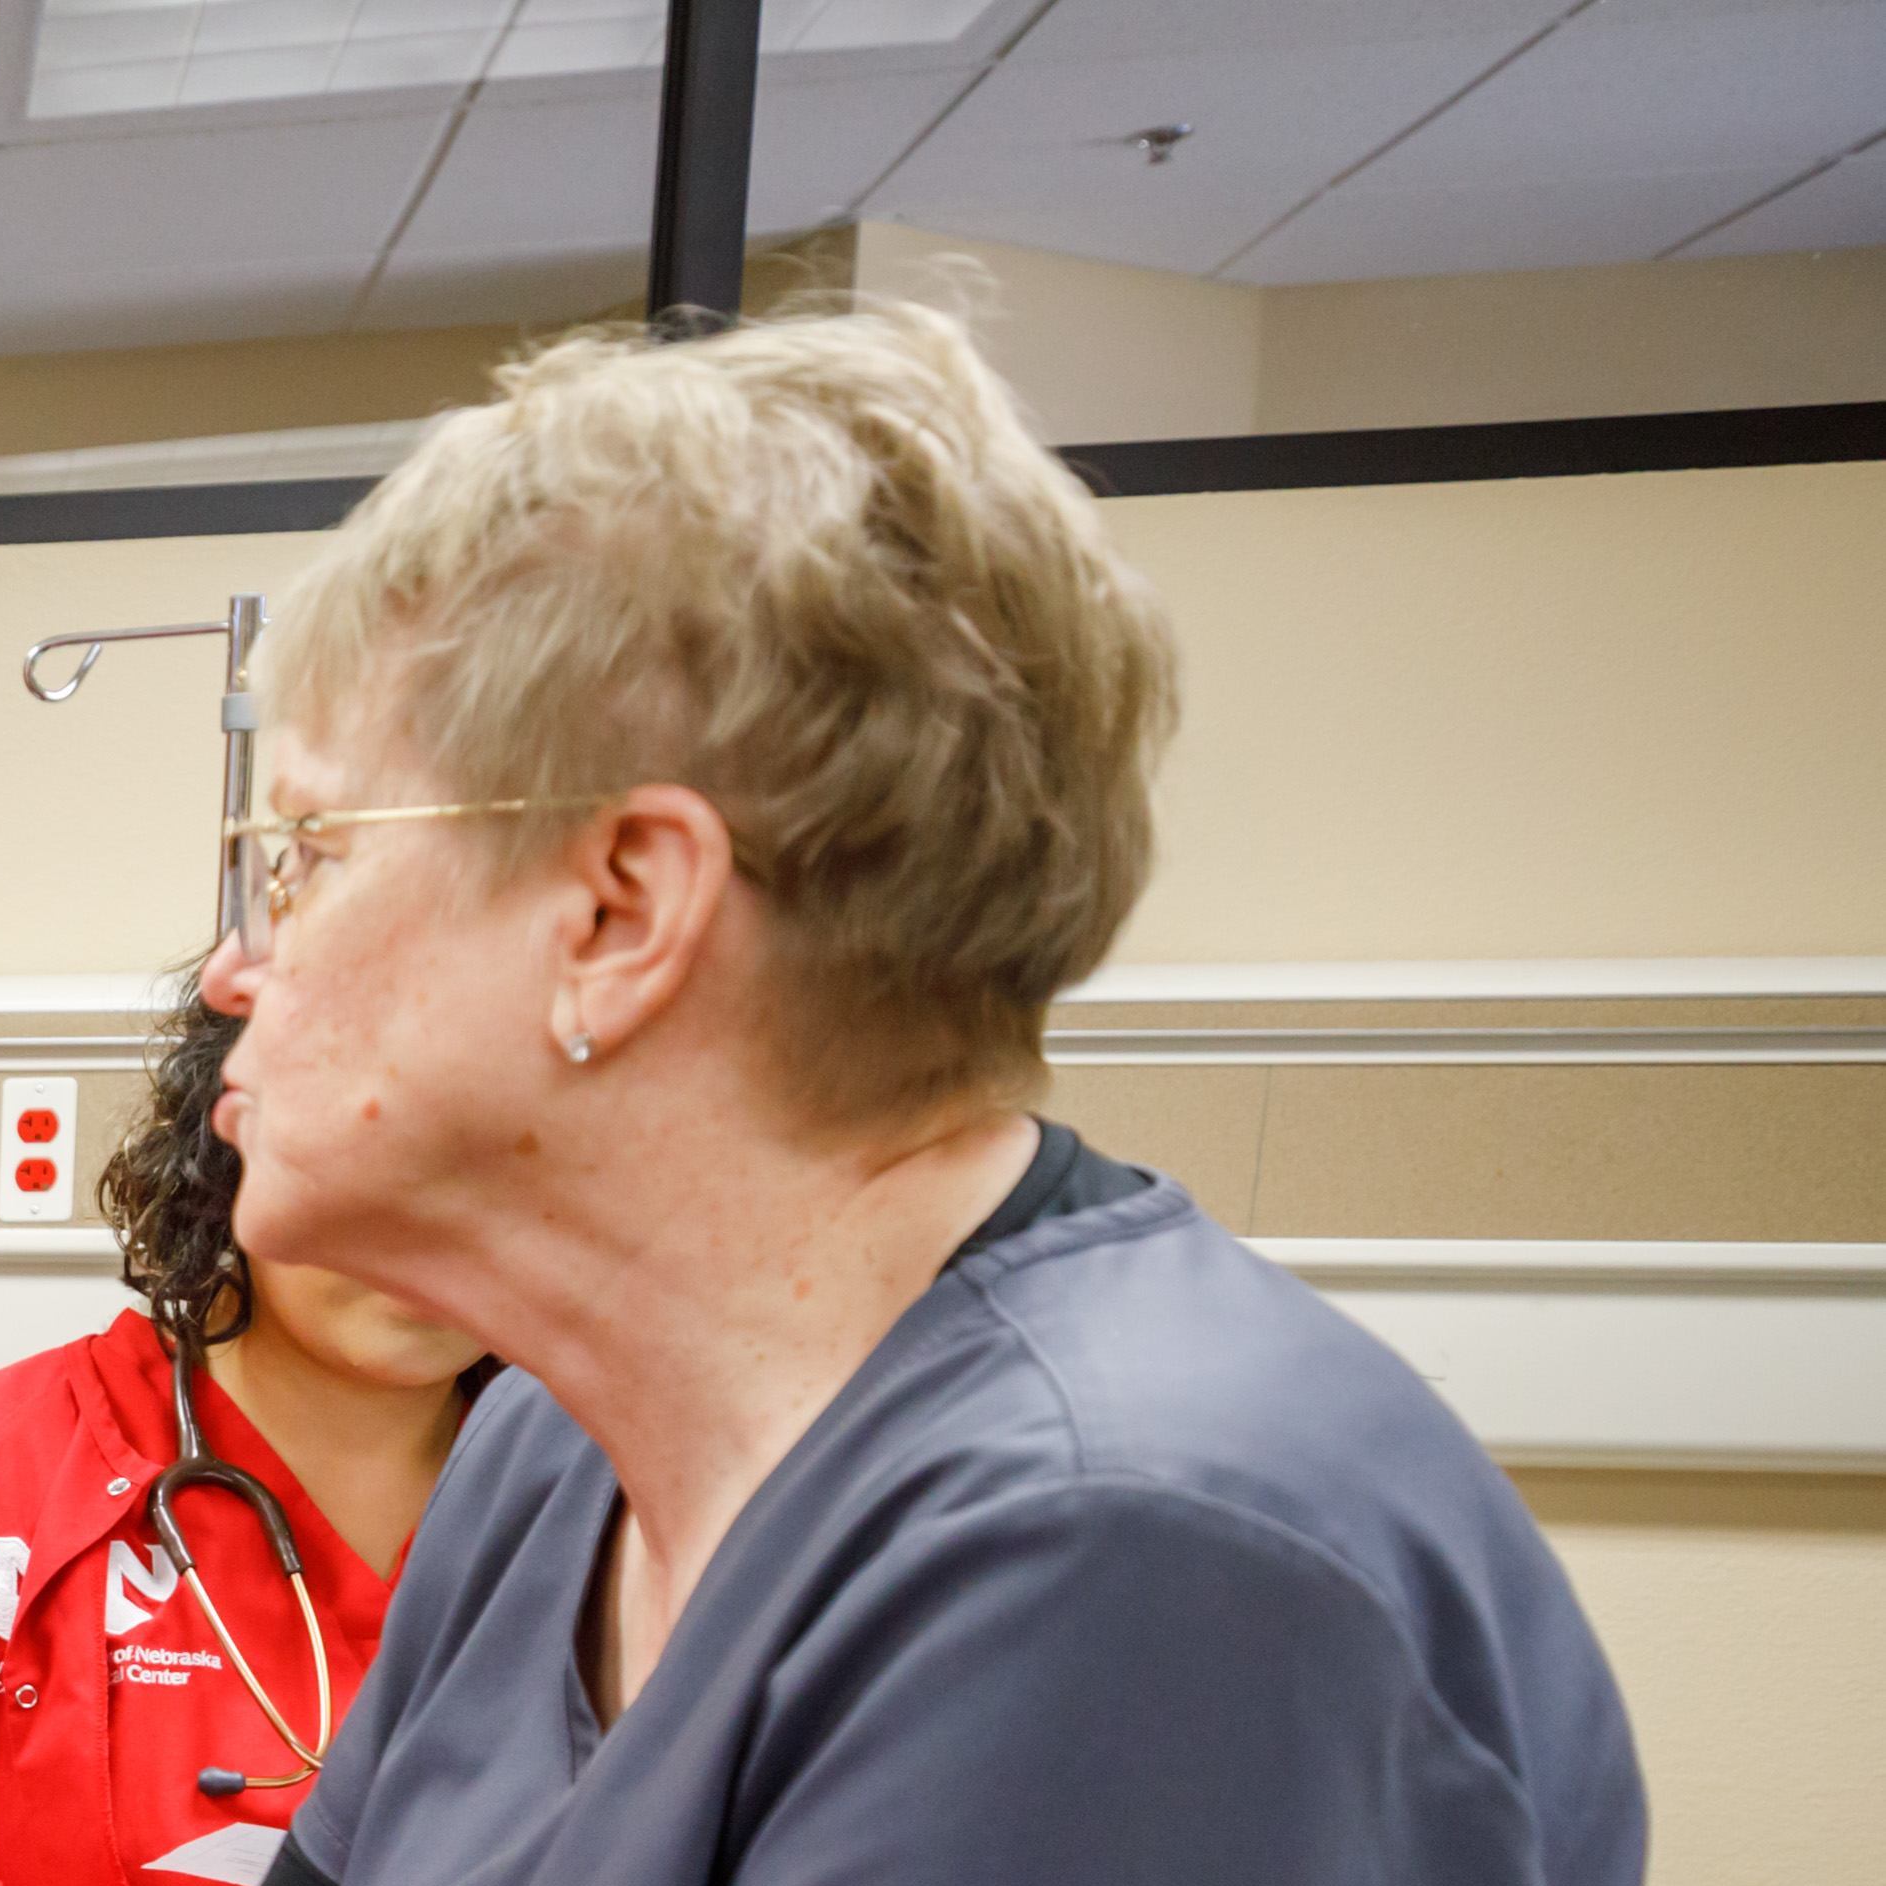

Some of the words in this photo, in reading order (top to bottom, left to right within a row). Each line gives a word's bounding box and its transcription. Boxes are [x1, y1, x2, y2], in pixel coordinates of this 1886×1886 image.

[113, 1645, 135, 1662] of
[135, 1645, 222, 1670] Nebraska
[127, 1664, 191, 1686] Center
